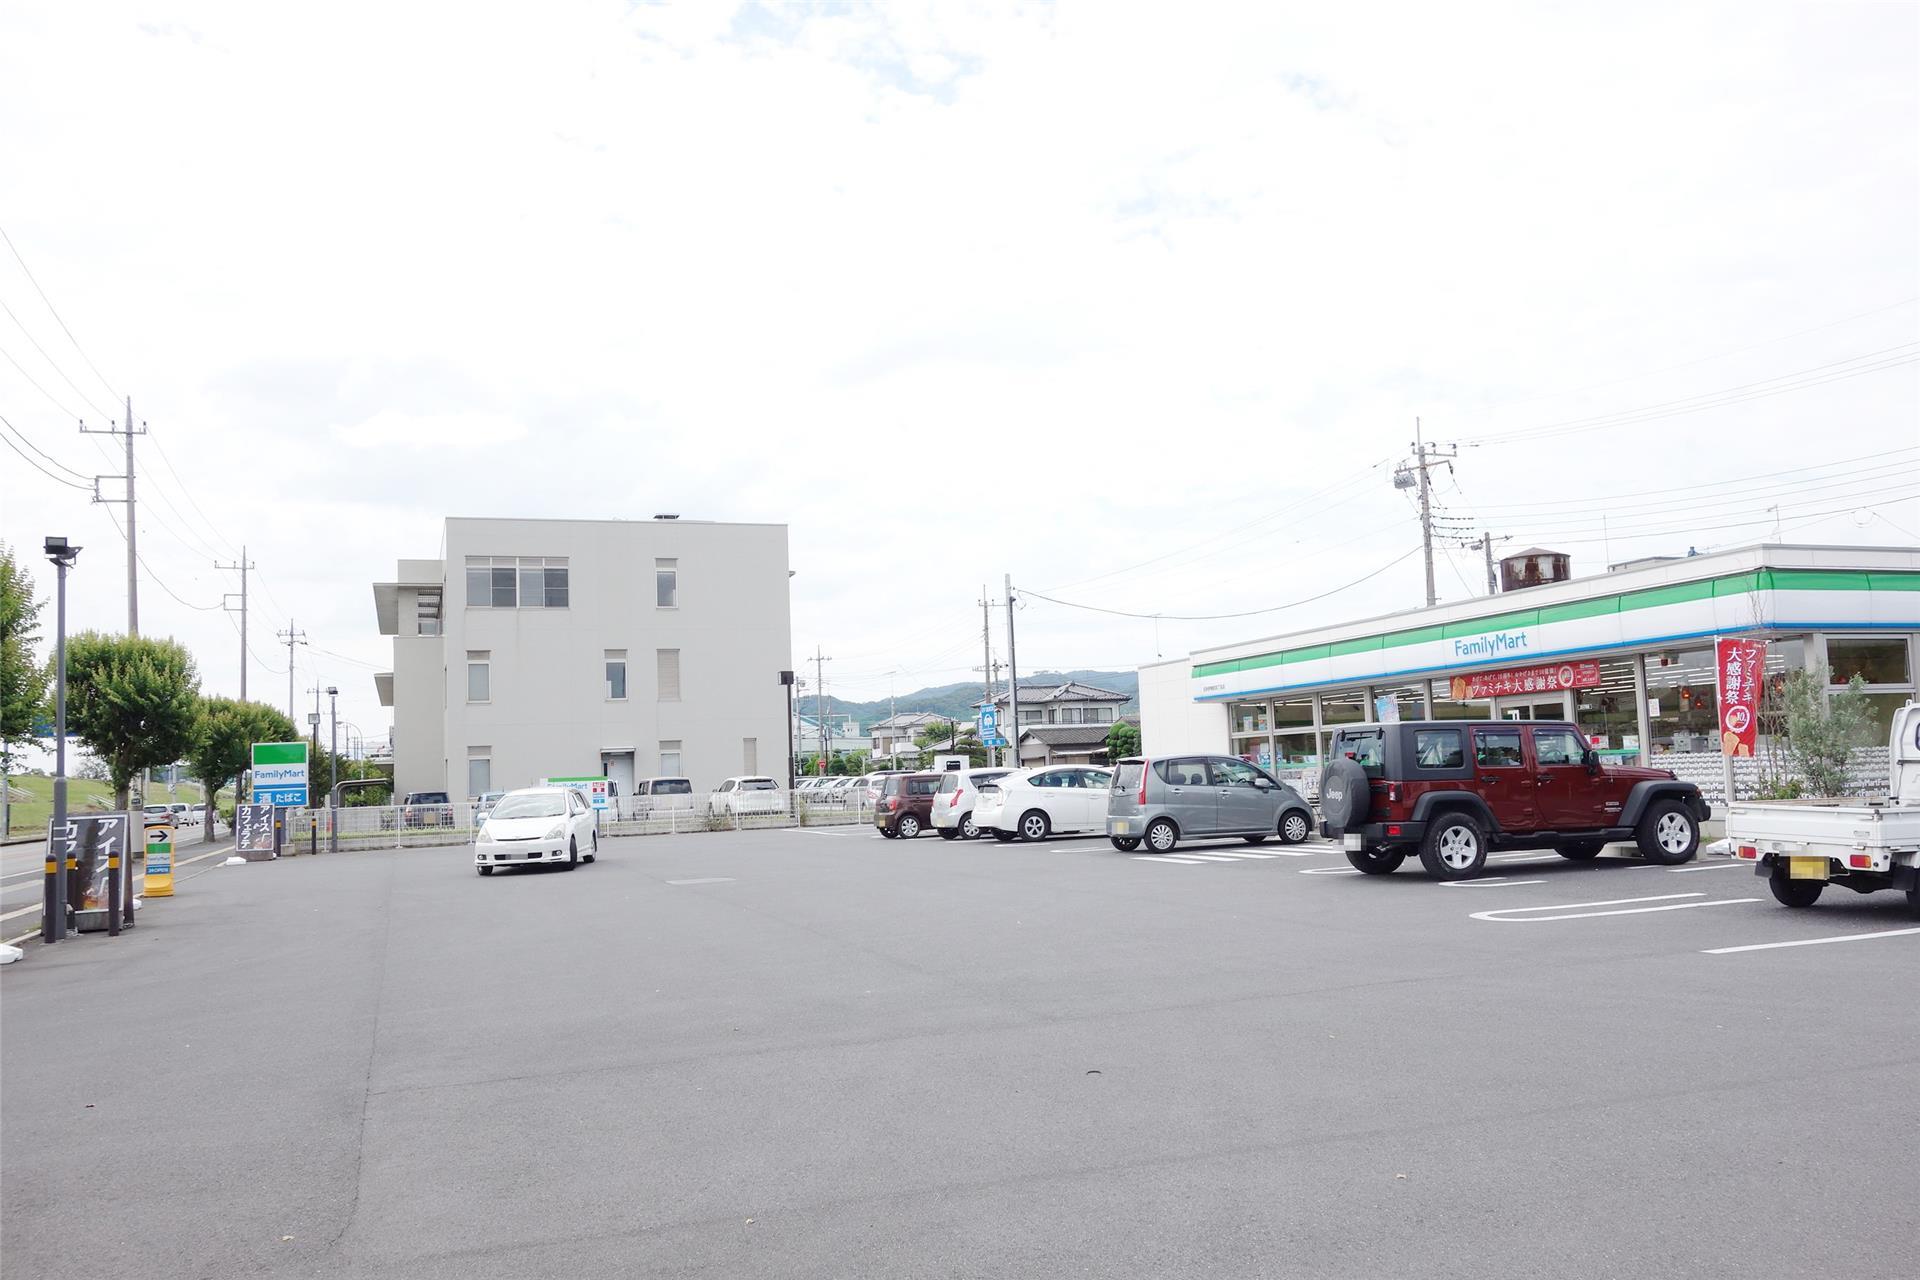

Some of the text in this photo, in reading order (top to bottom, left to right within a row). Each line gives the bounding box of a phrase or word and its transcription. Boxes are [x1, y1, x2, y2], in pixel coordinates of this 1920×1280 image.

[1454, 632, 1527, 656] FamilyMart
[1472, 675, 1558, 695] ファミチキ大感謝祭
[1726, 647, 1742, 704] 大感謝祭
[1742, 649, 1757, 704] ファミチキ
[254, 769, 305, 780] FamilyMart
[275, 793, 302, 803] たばこ
[1326, 788, 1343, 802] Jeep
[240, 806, 253, 849] カフェラテ
[260, 805, 271, 832] アイス
